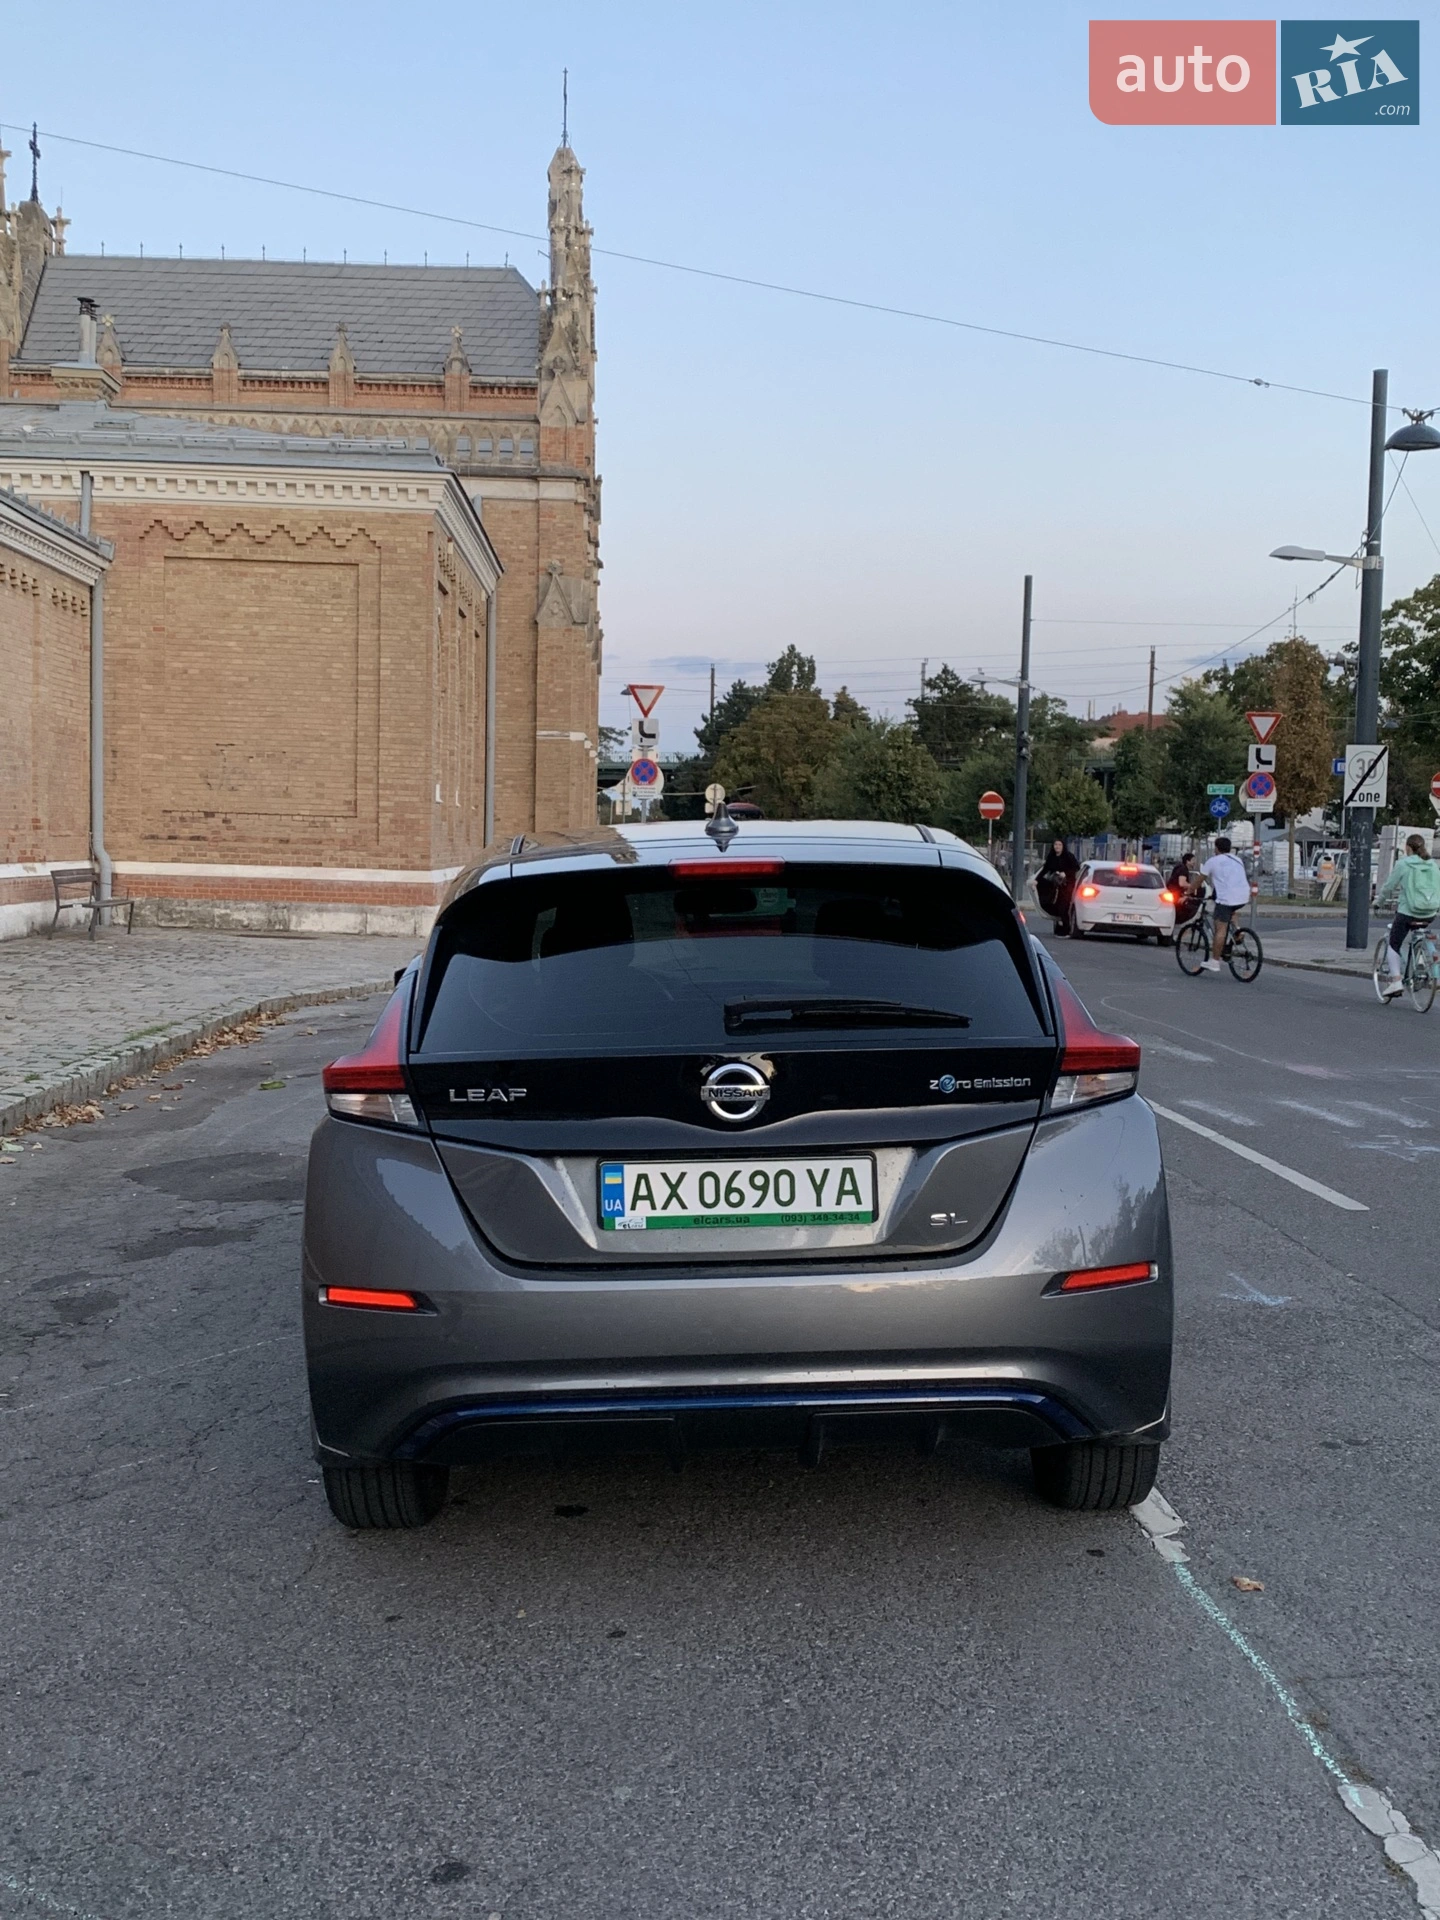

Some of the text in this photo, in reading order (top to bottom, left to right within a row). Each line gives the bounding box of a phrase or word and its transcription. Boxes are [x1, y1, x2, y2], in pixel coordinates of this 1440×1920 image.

[1355, 757, 1377, 779] 30
[973, 1077, 1032, 1089] Emission
[448, 1088, 528, 1103] LEAF
[708, 1087, 763, 1098] NISSAN
[630, 1166, 863, 1211] AX 0690 YA
[604, 1199, 623, 1211] UA
[693, 1215, 750, 1226] elcars.ua
[781, 1212, 861, 1225] (093) 348-34-34
[930, 1212, 969, 1226] SL
